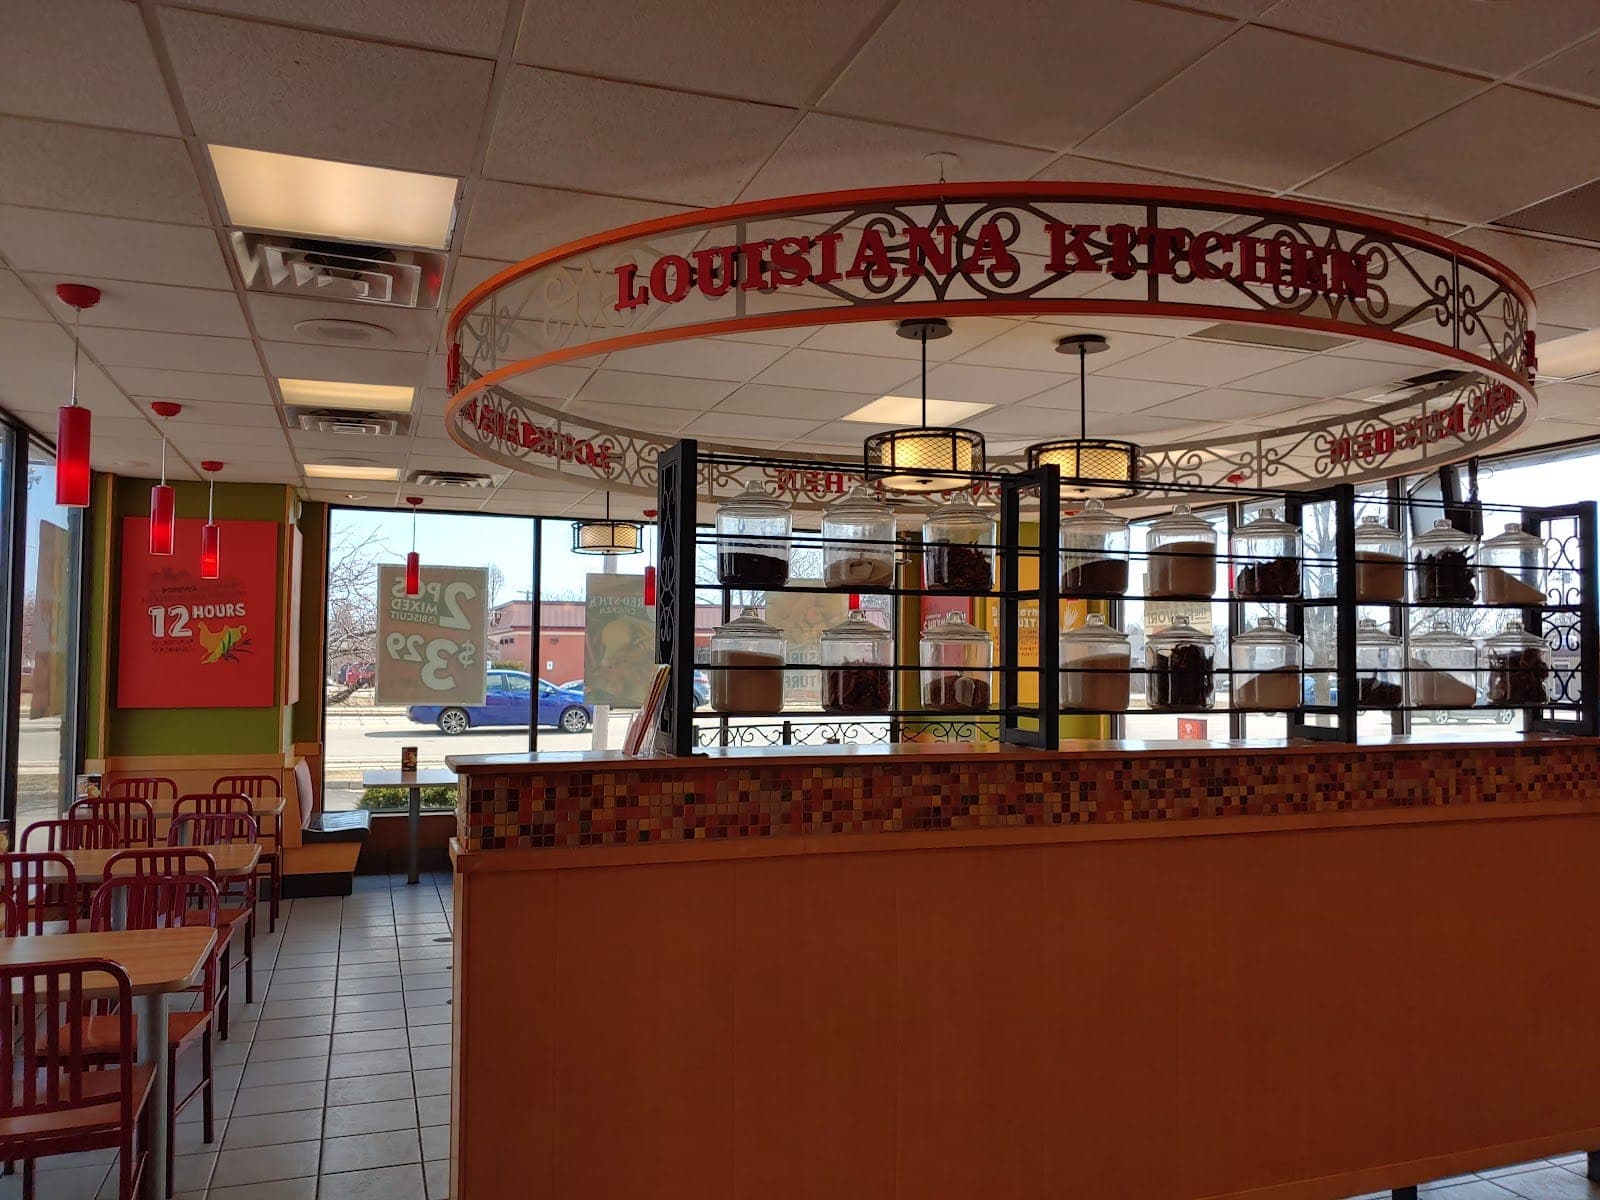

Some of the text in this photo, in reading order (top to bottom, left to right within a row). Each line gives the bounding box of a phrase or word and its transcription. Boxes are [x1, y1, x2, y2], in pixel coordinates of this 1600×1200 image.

[614, 222, 1368, 312] LOUISIANA KITCHEN
[148, 603, 247, 637] 12 HOURS
